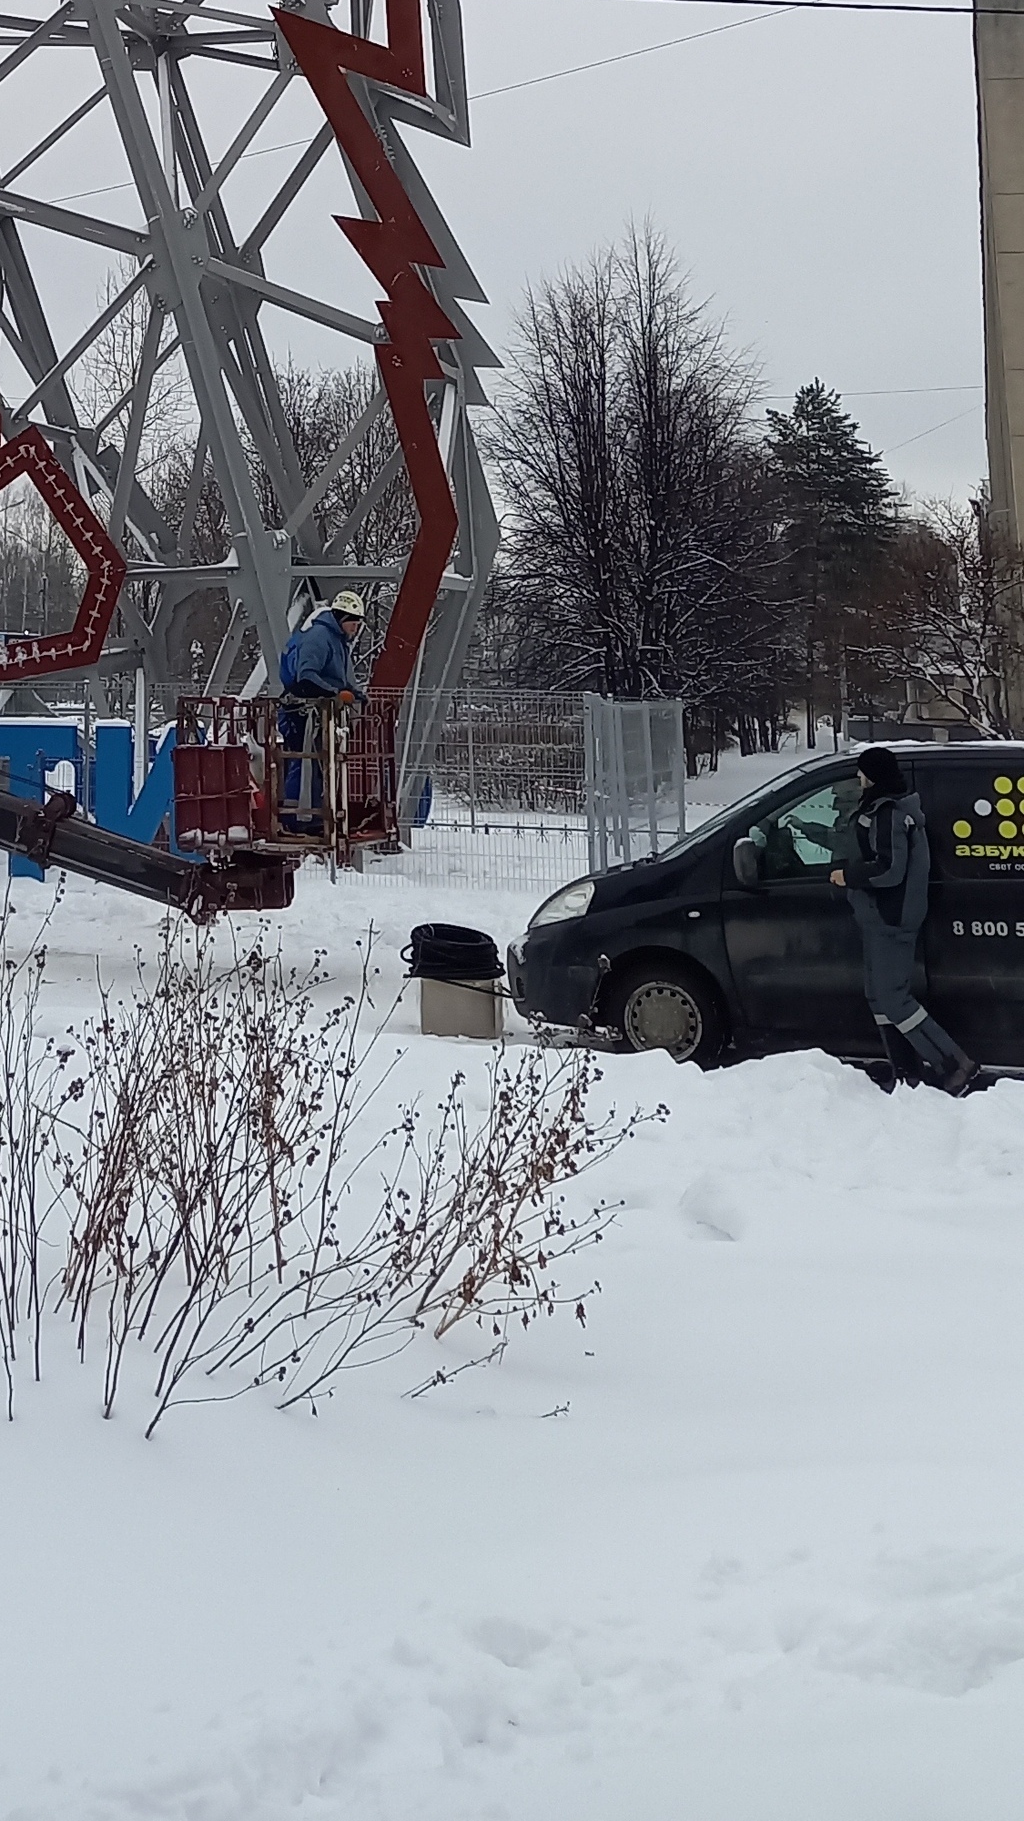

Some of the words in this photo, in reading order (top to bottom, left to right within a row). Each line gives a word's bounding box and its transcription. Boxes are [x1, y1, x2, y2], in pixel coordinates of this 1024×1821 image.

[955, 844, 1024, 860] азбук
[952, 920, 965, 936] 8
[971, 921, 1009, 937] 800
[1015, 922, 1024, 937] 5
